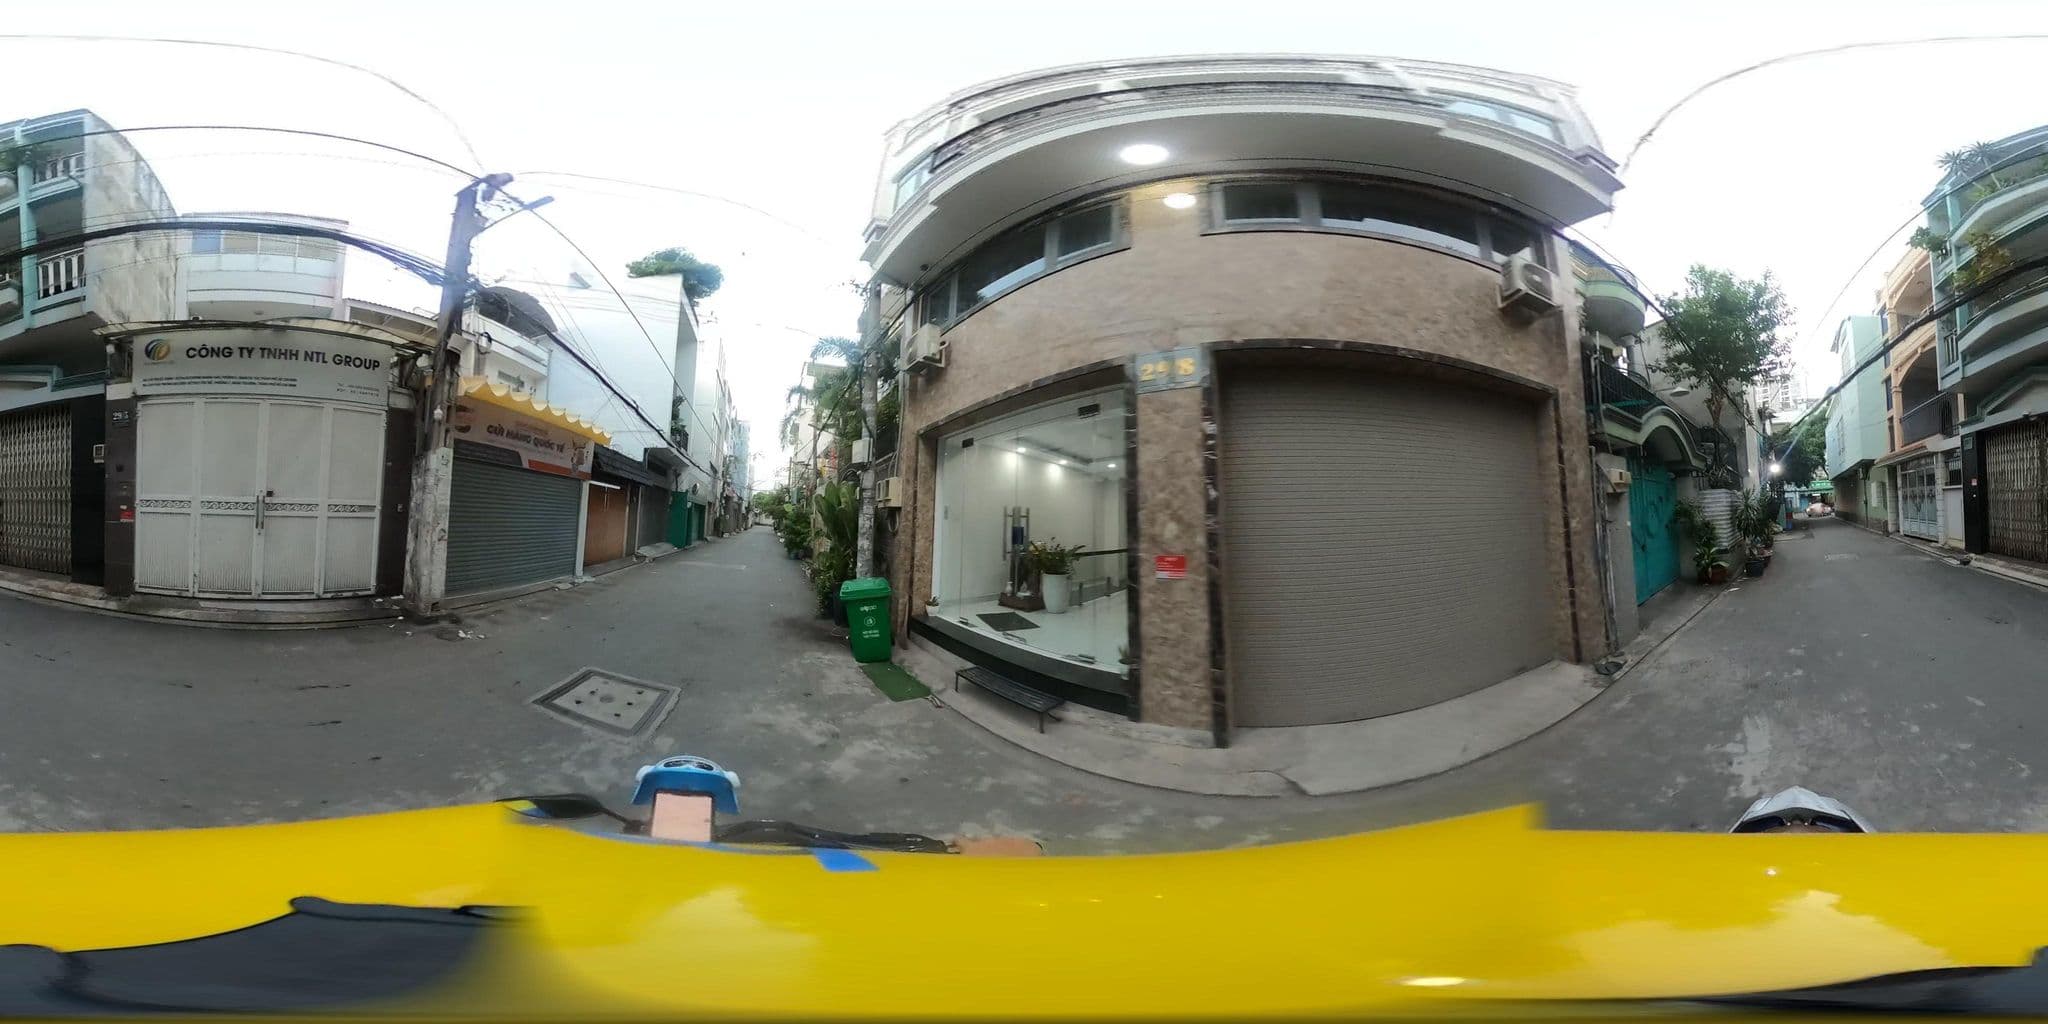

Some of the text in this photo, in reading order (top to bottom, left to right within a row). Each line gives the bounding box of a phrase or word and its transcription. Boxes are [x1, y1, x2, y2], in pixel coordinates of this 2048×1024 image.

[186, 343, 380, 371] CÔNG TY TNHH NTL GROUP
